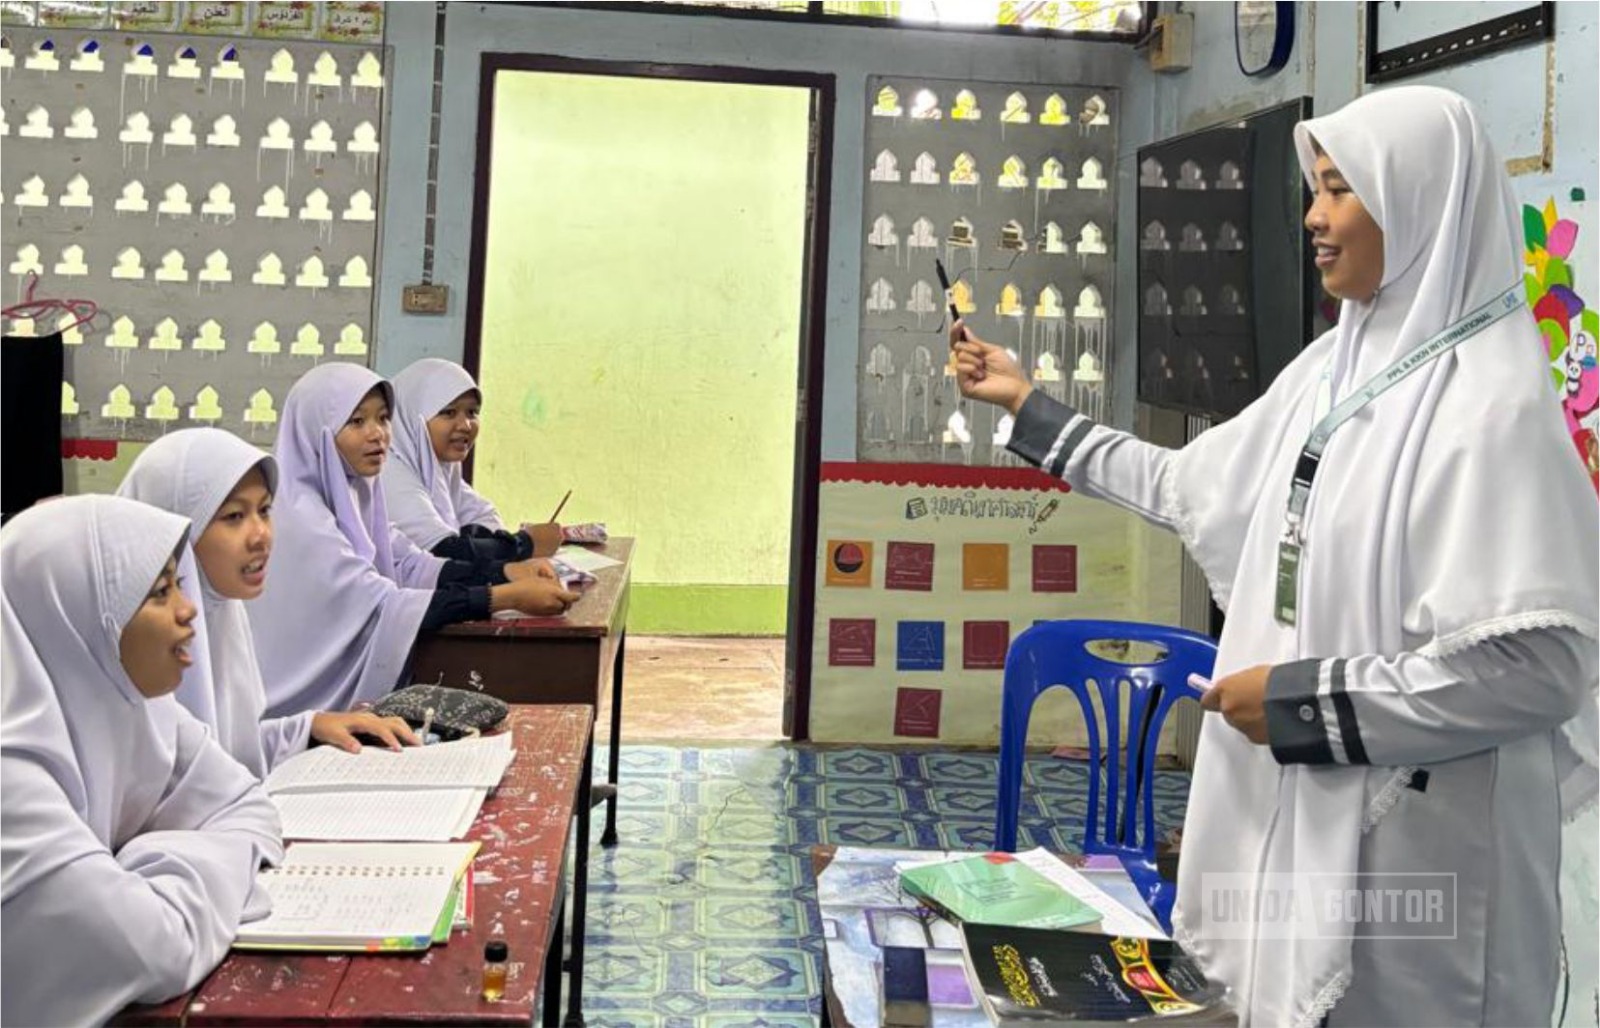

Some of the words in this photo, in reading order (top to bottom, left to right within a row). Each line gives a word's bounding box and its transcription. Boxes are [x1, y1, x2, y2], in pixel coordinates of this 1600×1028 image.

[1388, 365, 1404, 381] PPL
[1410, 348, 1429, 366] KKN
[1428, 313, 1493, 352] INTERNATIONAL
